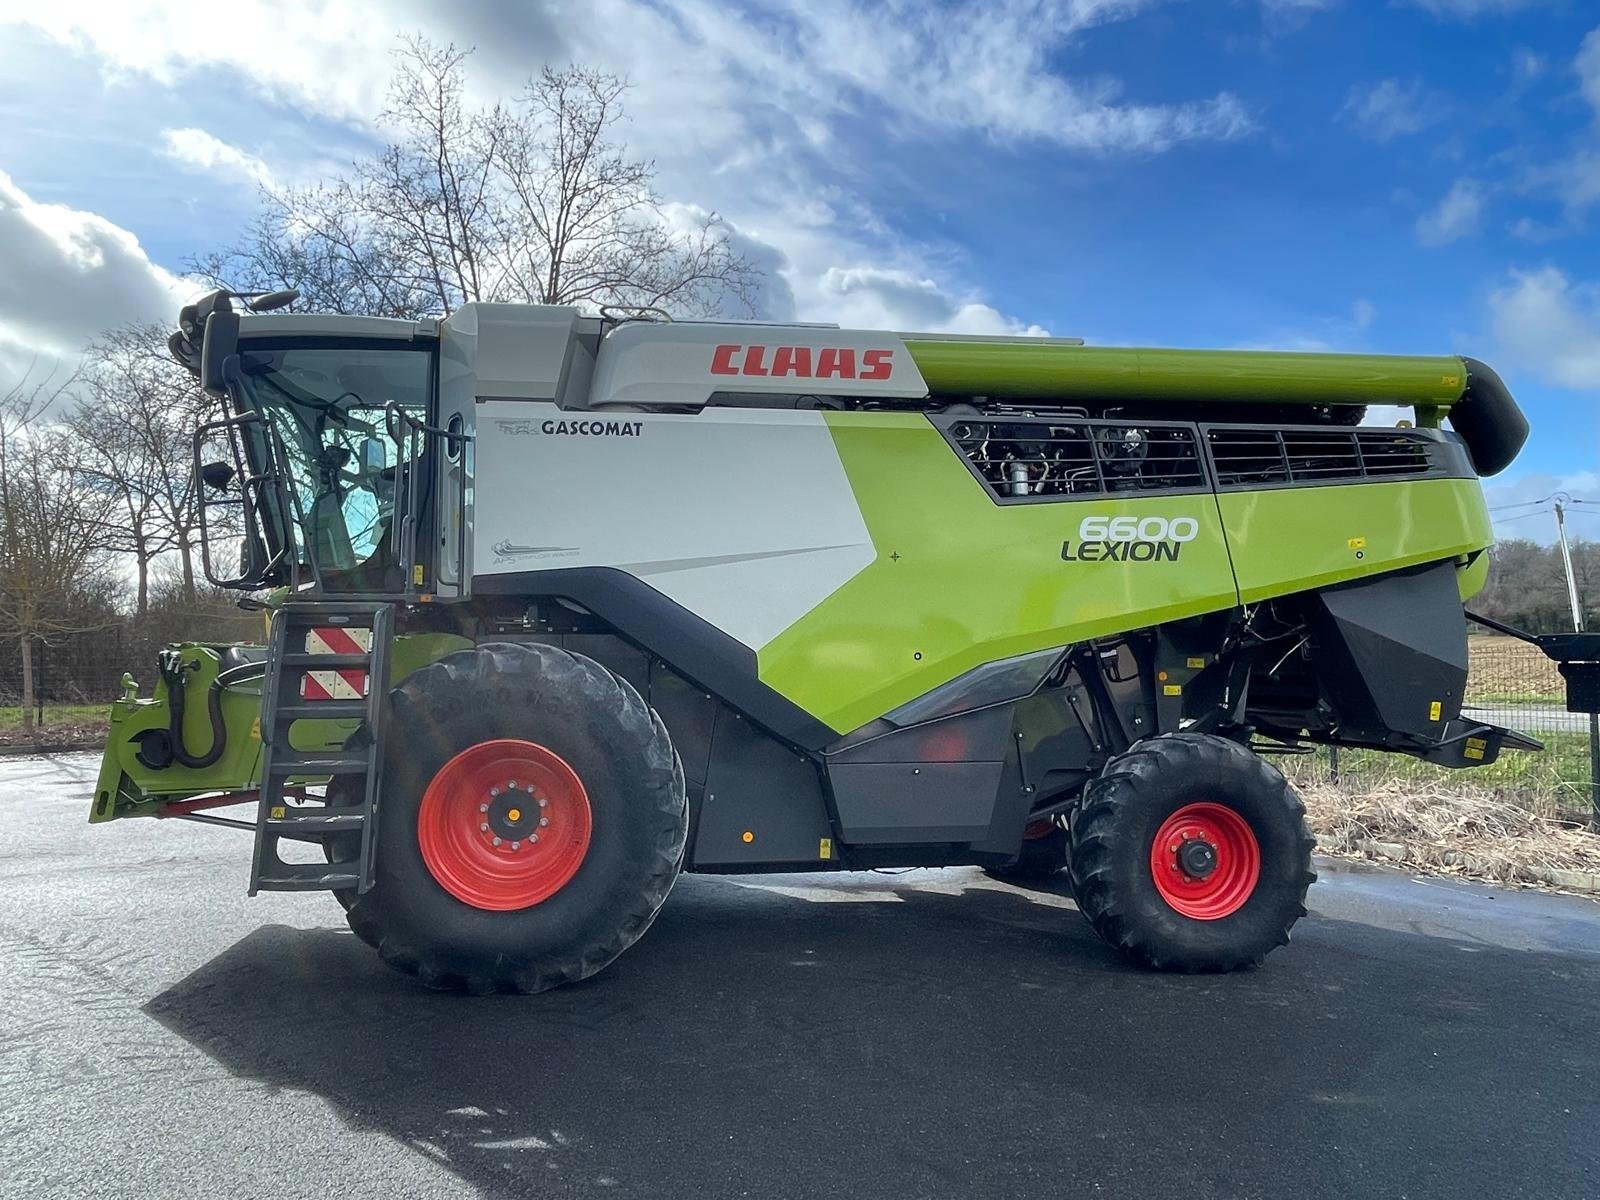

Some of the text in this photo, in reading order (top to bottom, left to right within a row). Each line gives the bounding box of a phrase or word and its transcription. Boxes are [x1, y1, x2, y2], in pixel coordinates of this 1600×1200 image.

[710, 344, 894, 380] CLAAS
[542, 420, 643, 437] GASCOMAT
[1079, 516, 1199, 542] 6600
[1061, 541, 1181, 562] LEXION
